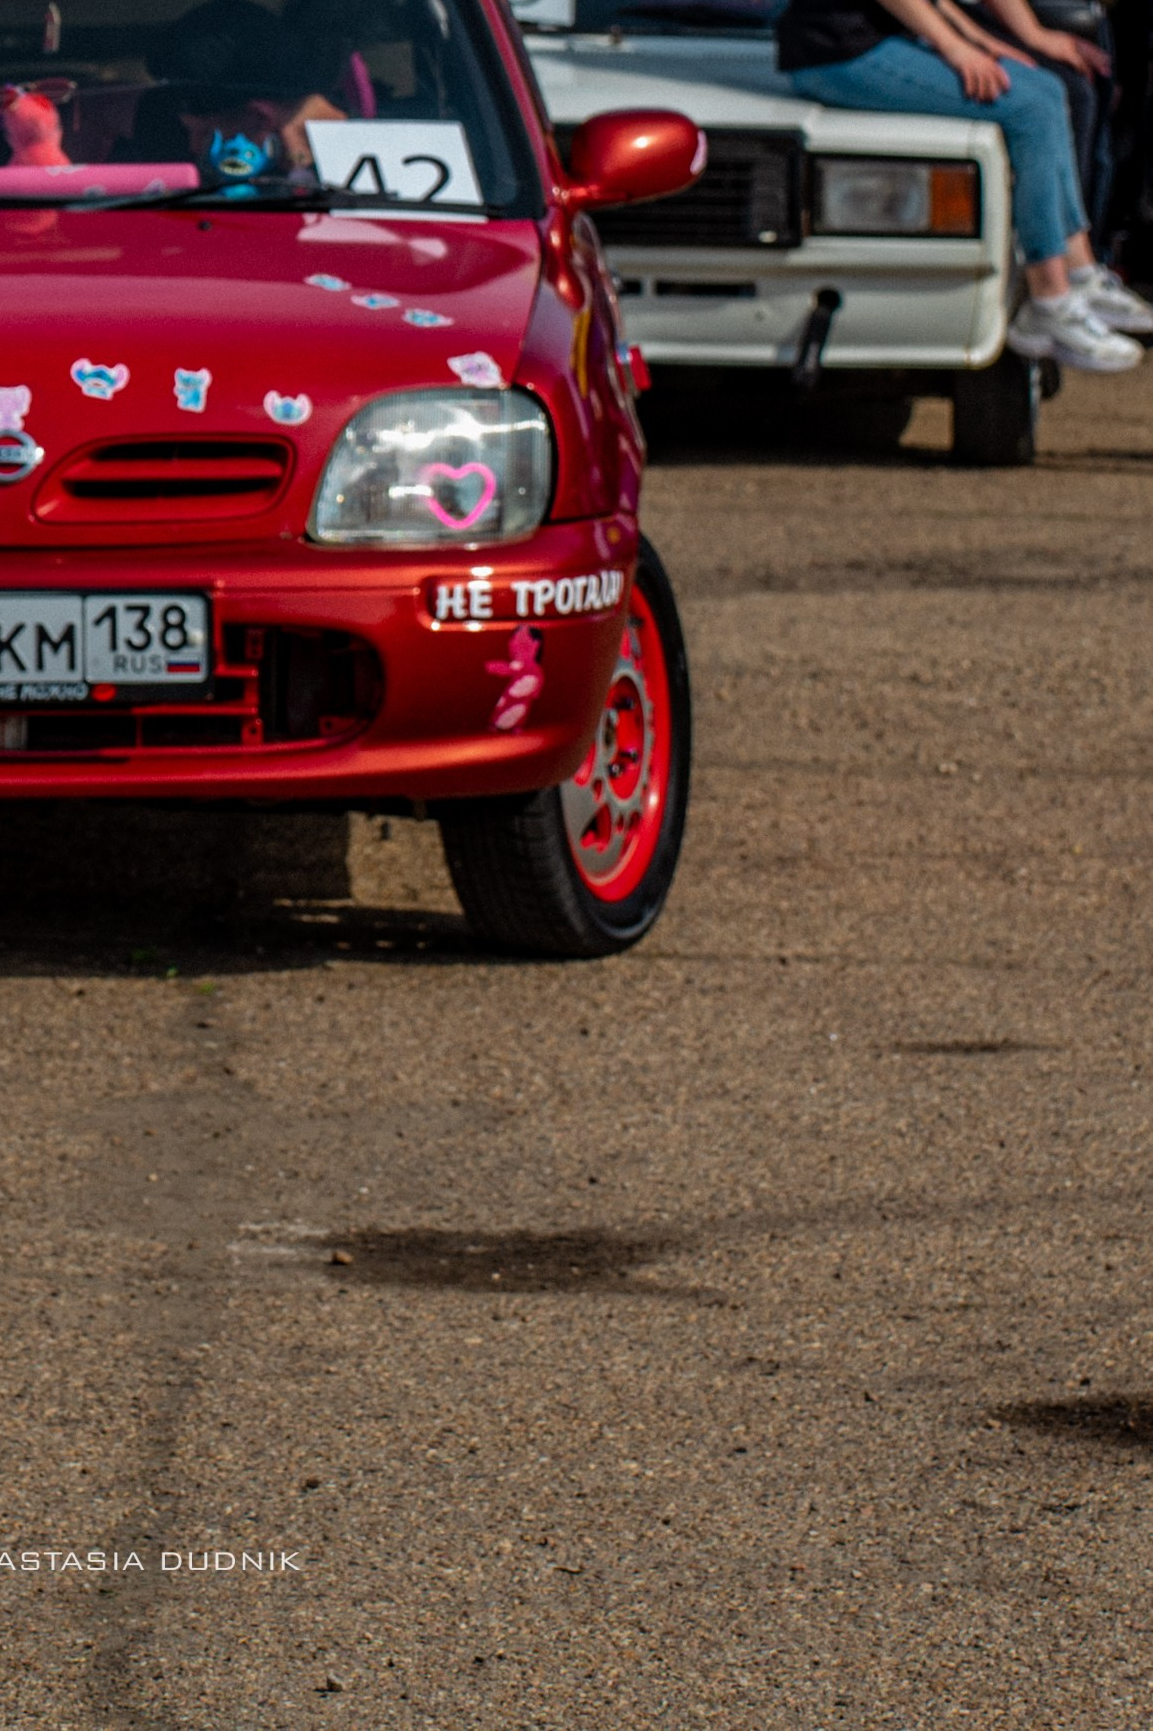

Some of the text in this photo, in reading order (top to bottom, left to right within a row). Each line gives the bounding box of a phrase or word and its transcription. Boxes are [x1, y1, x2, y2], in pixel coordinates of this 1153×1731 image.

[436, 582, 494, 620] НЕ
[93, 603, 188, 652] 138
[113, 653, 163, 672] RUS
